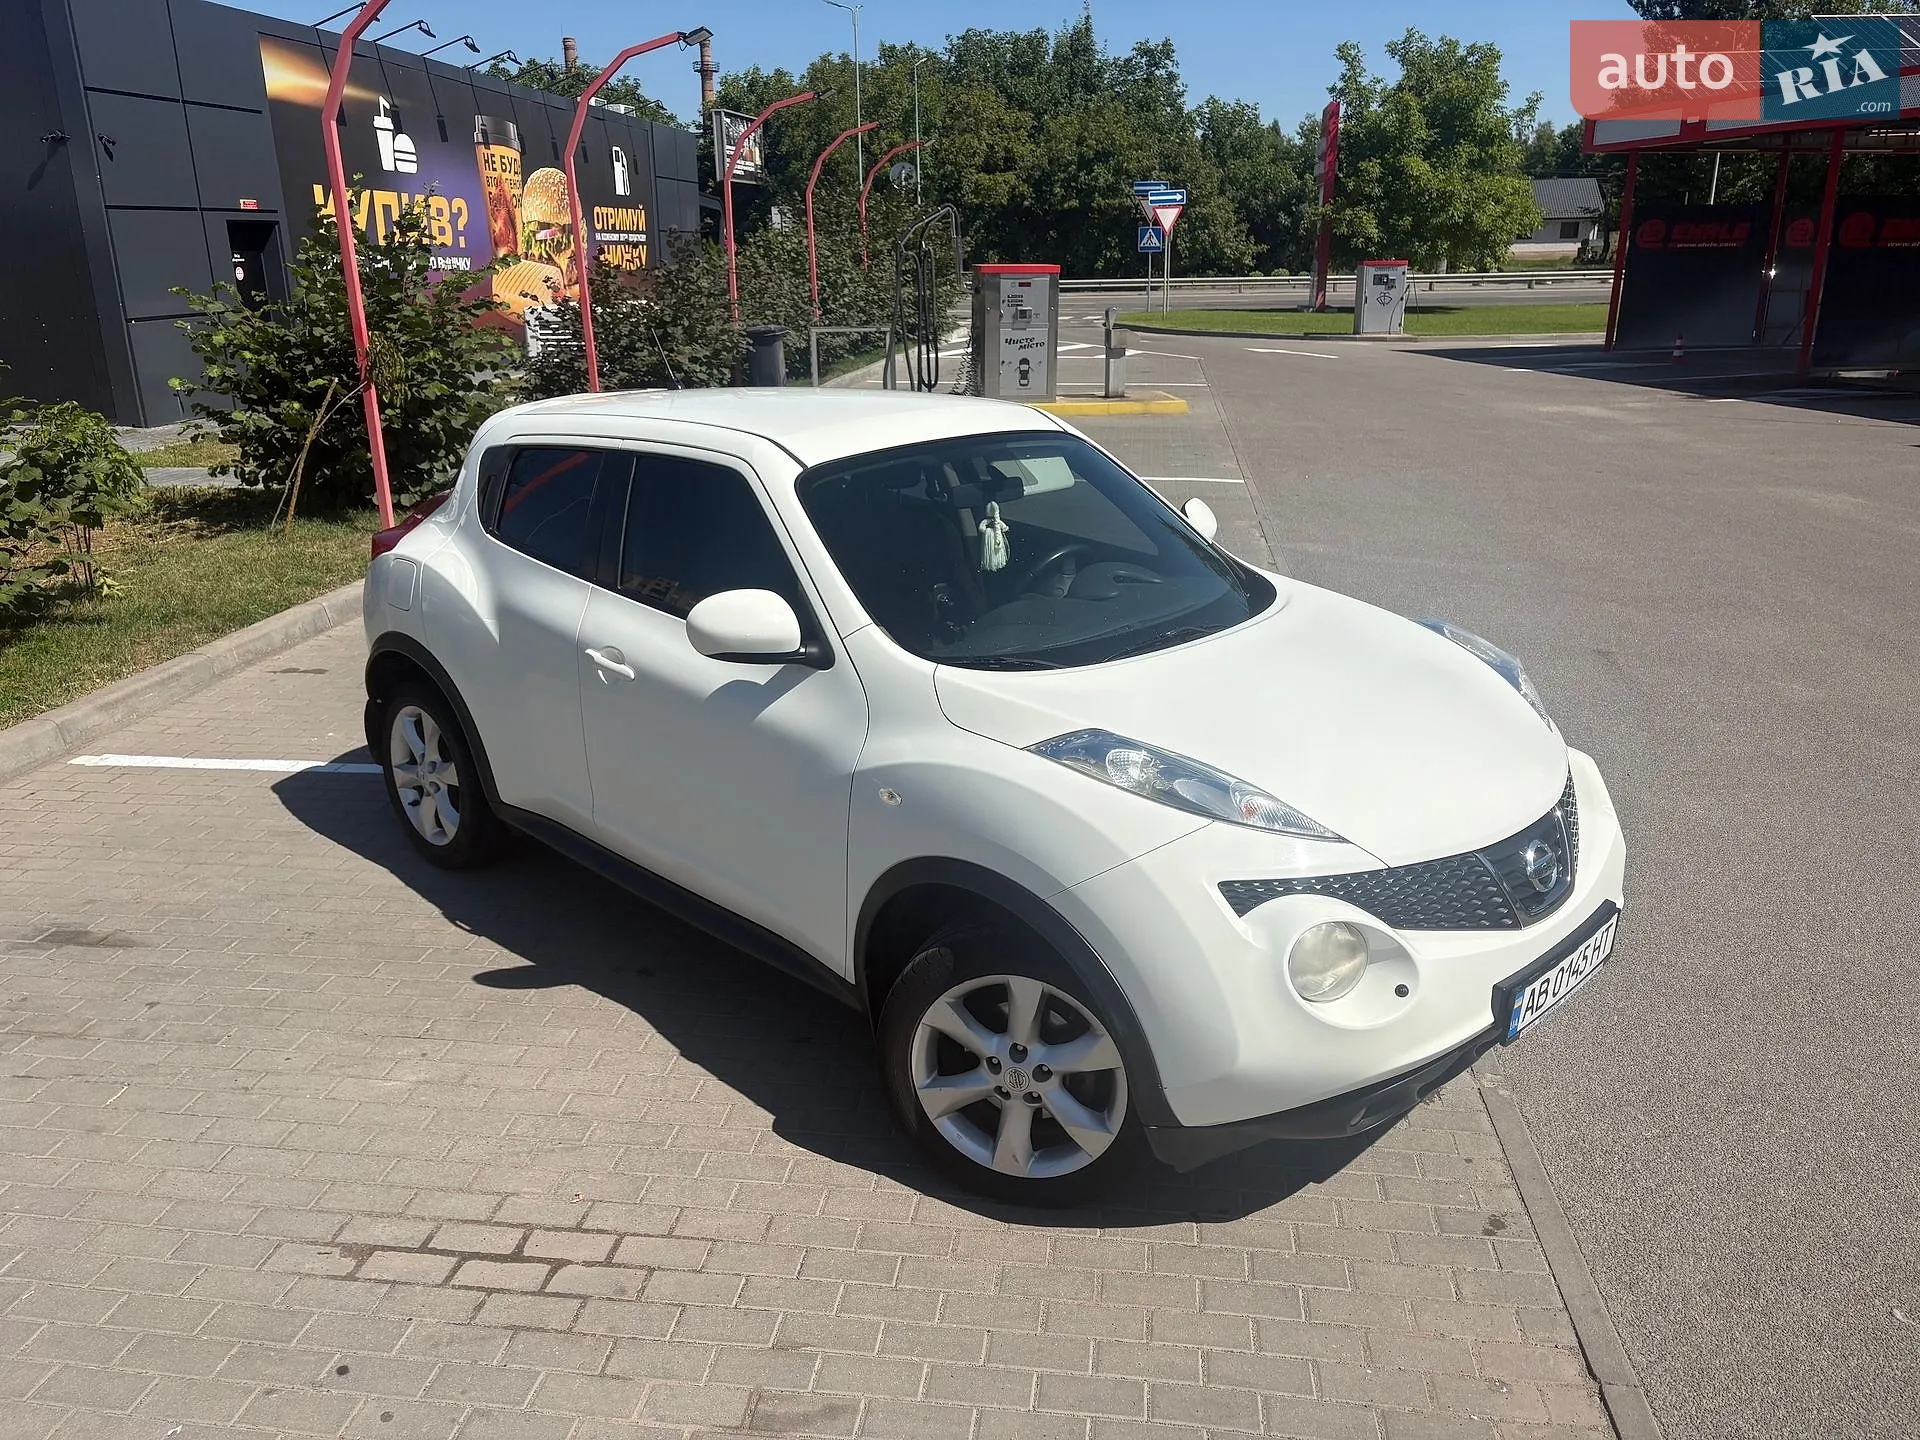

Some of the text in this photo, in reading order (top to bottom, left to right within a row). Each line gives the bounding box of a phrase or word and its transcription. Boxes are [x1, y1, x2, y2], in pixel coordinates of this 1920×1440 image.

[482, 151, 498, 173] НЕ
[594, 204, 646, 231] ОТРИМУЙ
[599, 244, 647, 270] НИЖКУ
[1004, 337, 1035, 346] Чисте
[1018, 341, 1045, 351] місто
[1521, 922, 1615, 1024] AB 0145 HT
